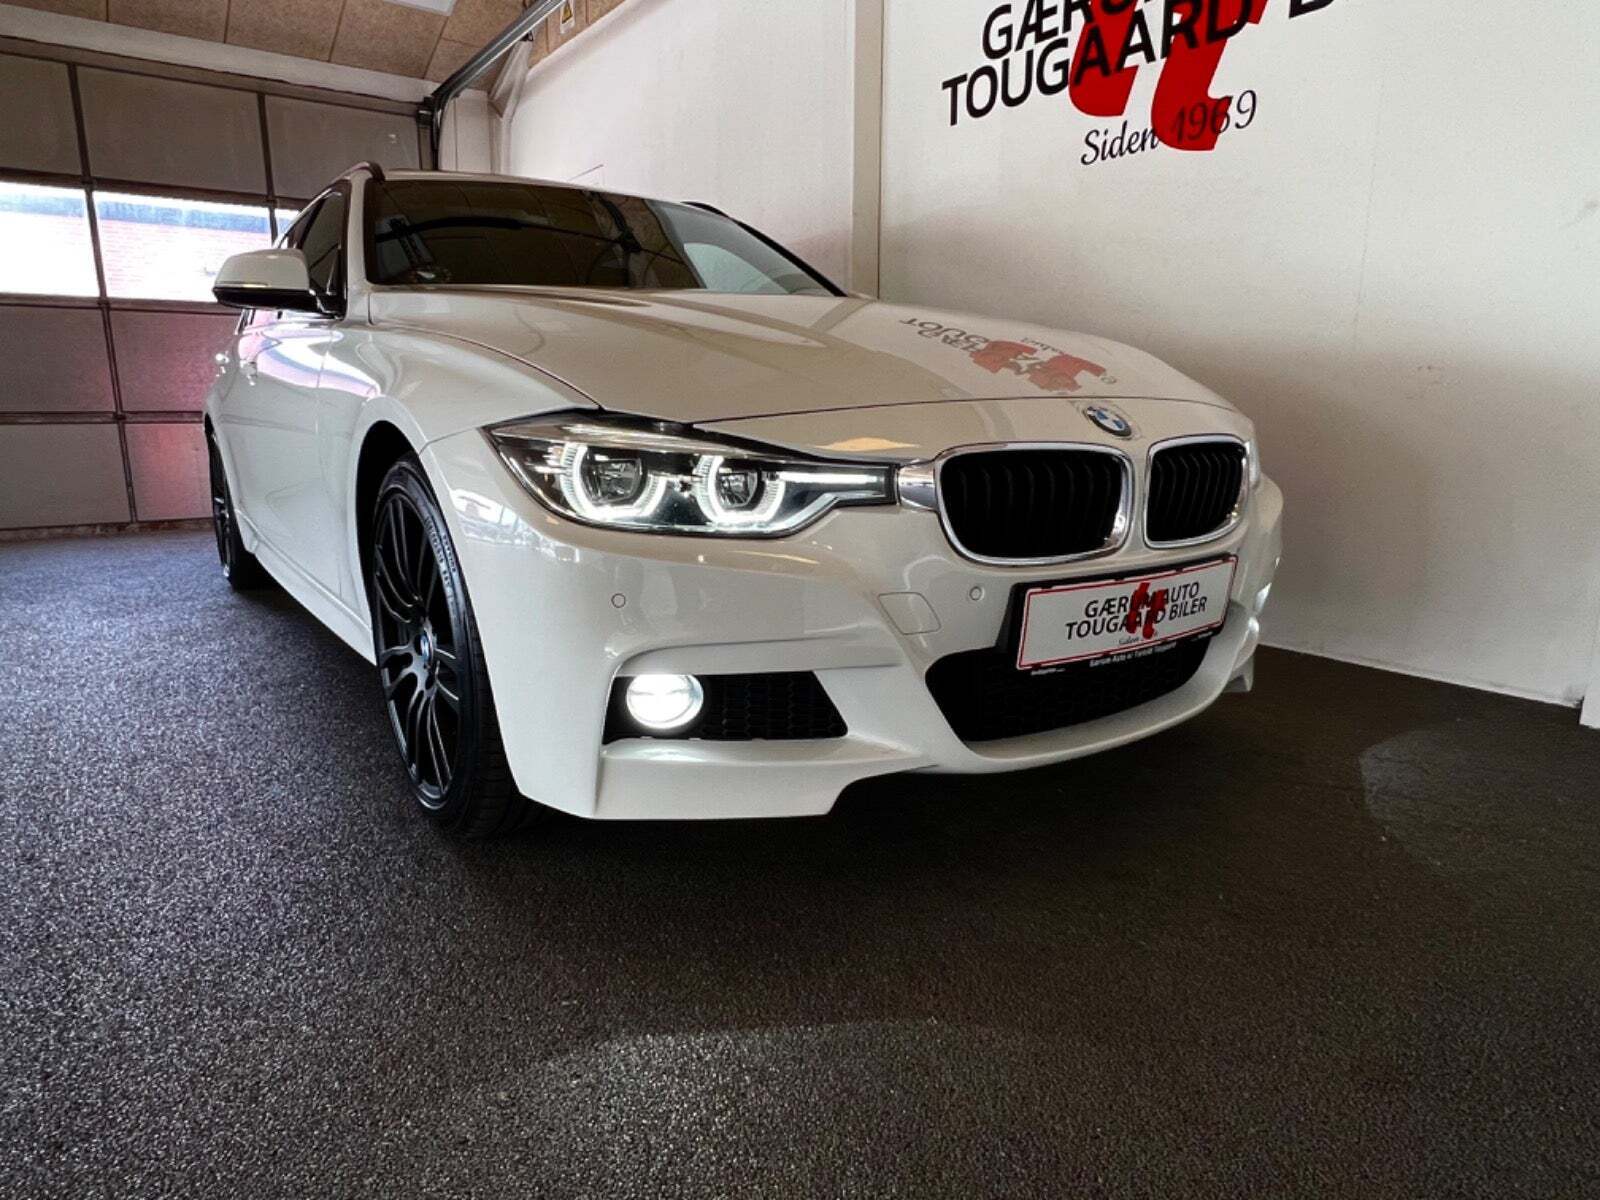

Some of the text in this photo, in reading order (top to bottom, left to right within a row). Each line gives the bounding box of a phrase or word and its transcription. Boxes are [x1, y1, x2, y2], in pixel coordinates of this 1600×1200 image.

[941, 0, 1251, 126] TOUGAARD
[982, 0, 1150, 60] GÆR
[1080, 90, 1257, 165] Siden 1969
[1169, 597, 1207, 621] BILER
